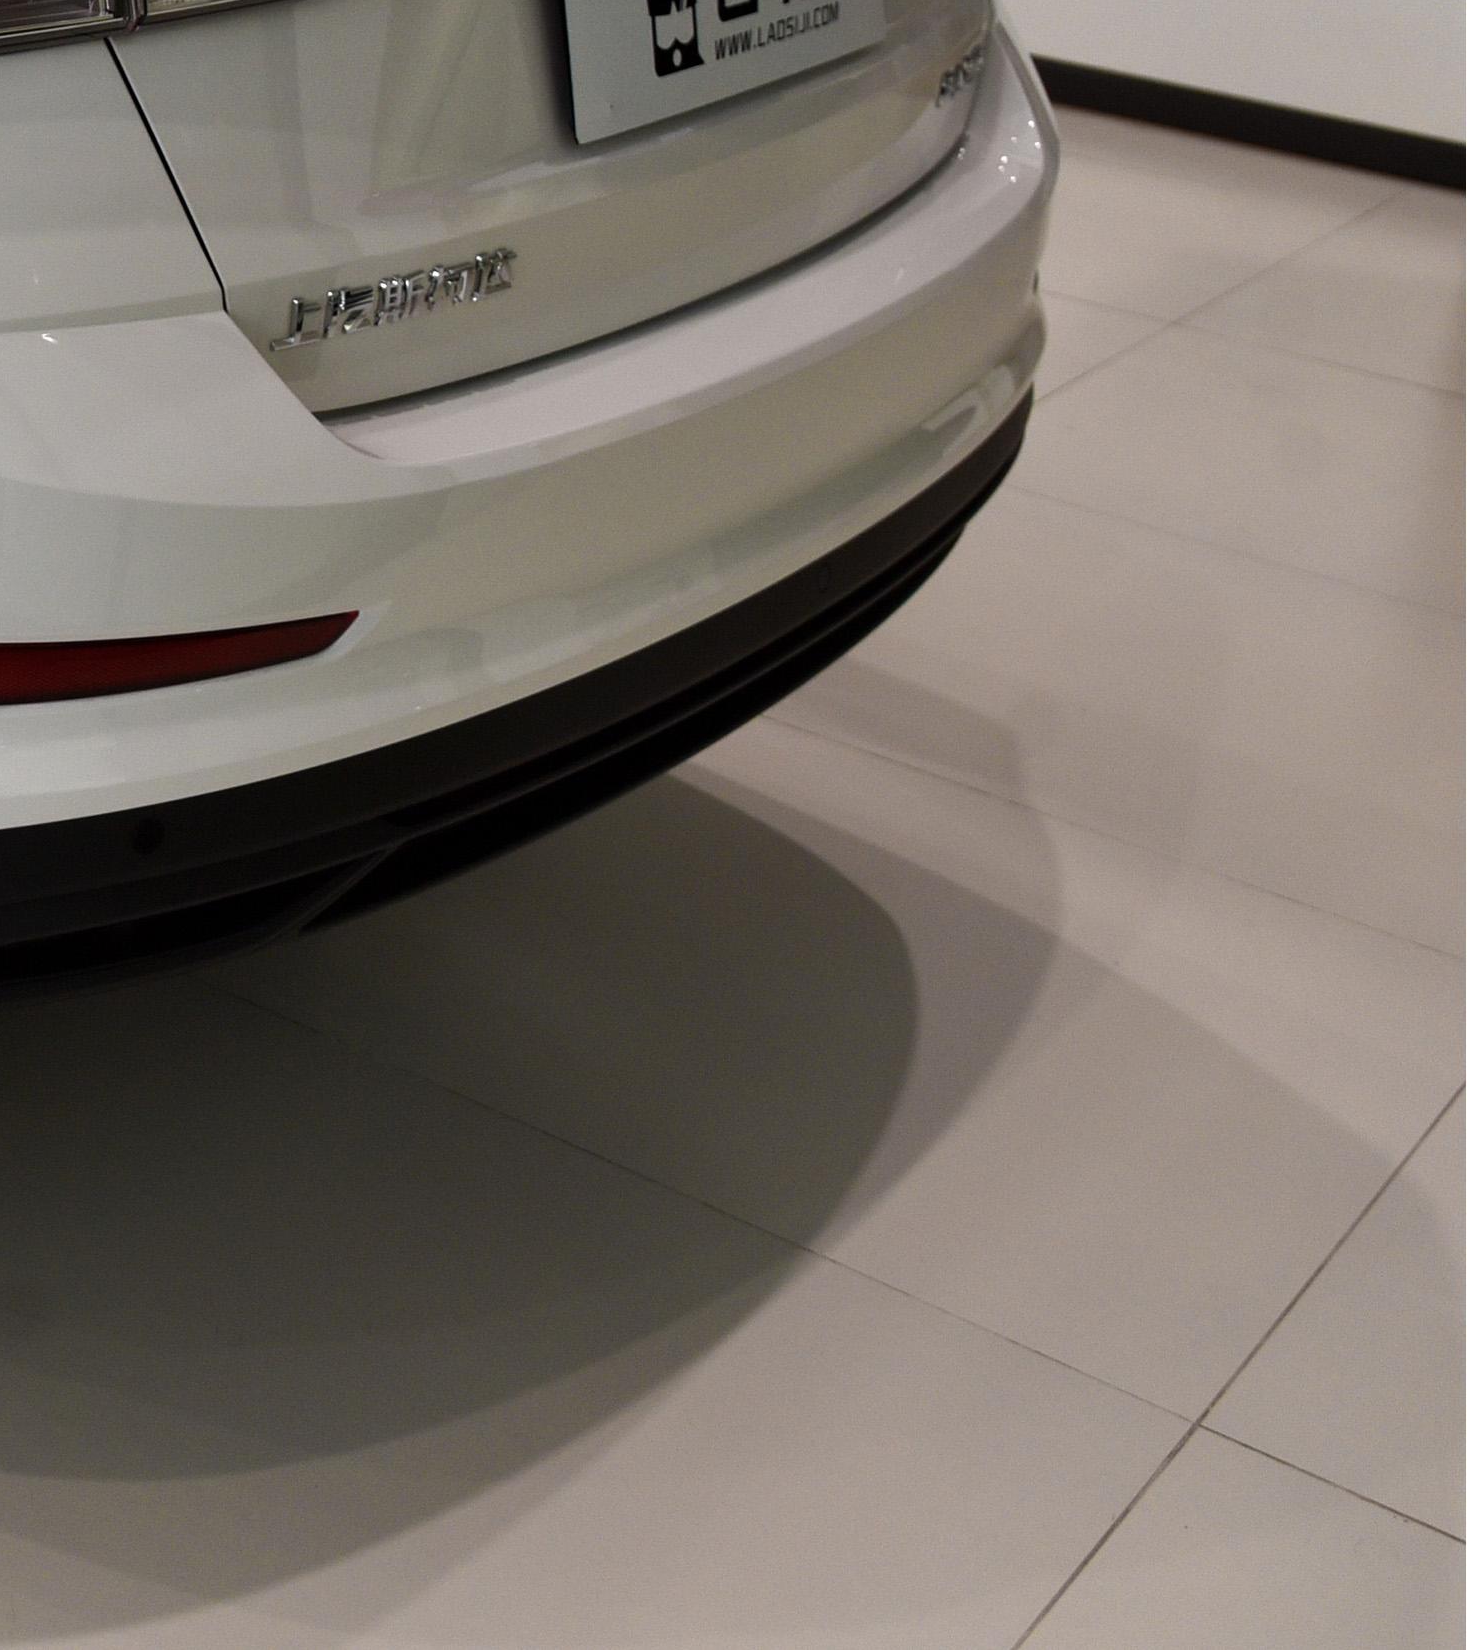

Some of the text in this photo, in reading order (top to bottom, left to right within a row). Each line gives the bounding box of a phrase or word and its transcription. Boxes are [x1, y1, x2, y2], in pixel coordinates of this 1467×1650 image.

[714, 1, 840, 62] WWW.LAOSIJI.COM
[270, 248, 517, 351] 上汽斯柯达
